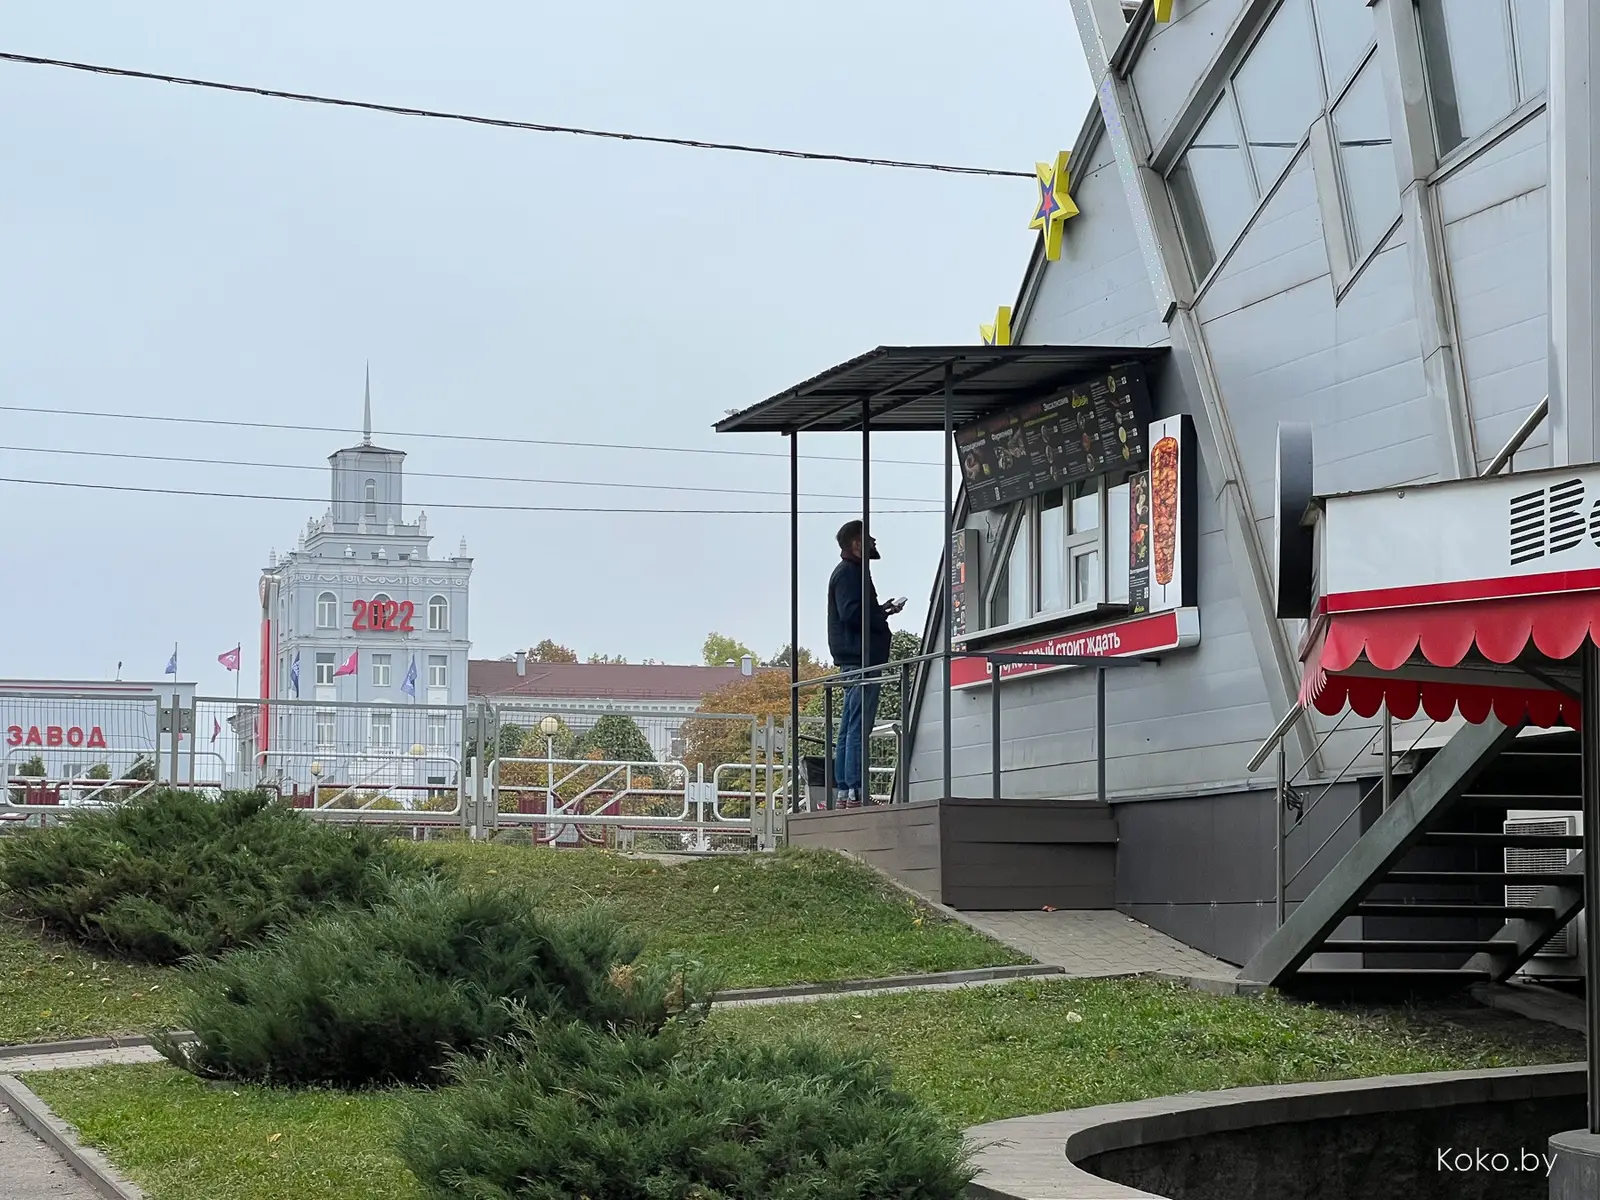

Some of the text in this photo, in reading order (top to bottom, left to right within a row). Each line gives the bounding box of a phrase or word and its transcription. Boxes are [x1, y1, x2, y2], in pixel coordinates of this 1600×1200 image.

[352, 599, 415, 632] 2022
[1055, 638, 1085, 656] стоит
[1086, 632, 1121, 656] ждать
[6, 725, 107, 748] ЗАВОД
